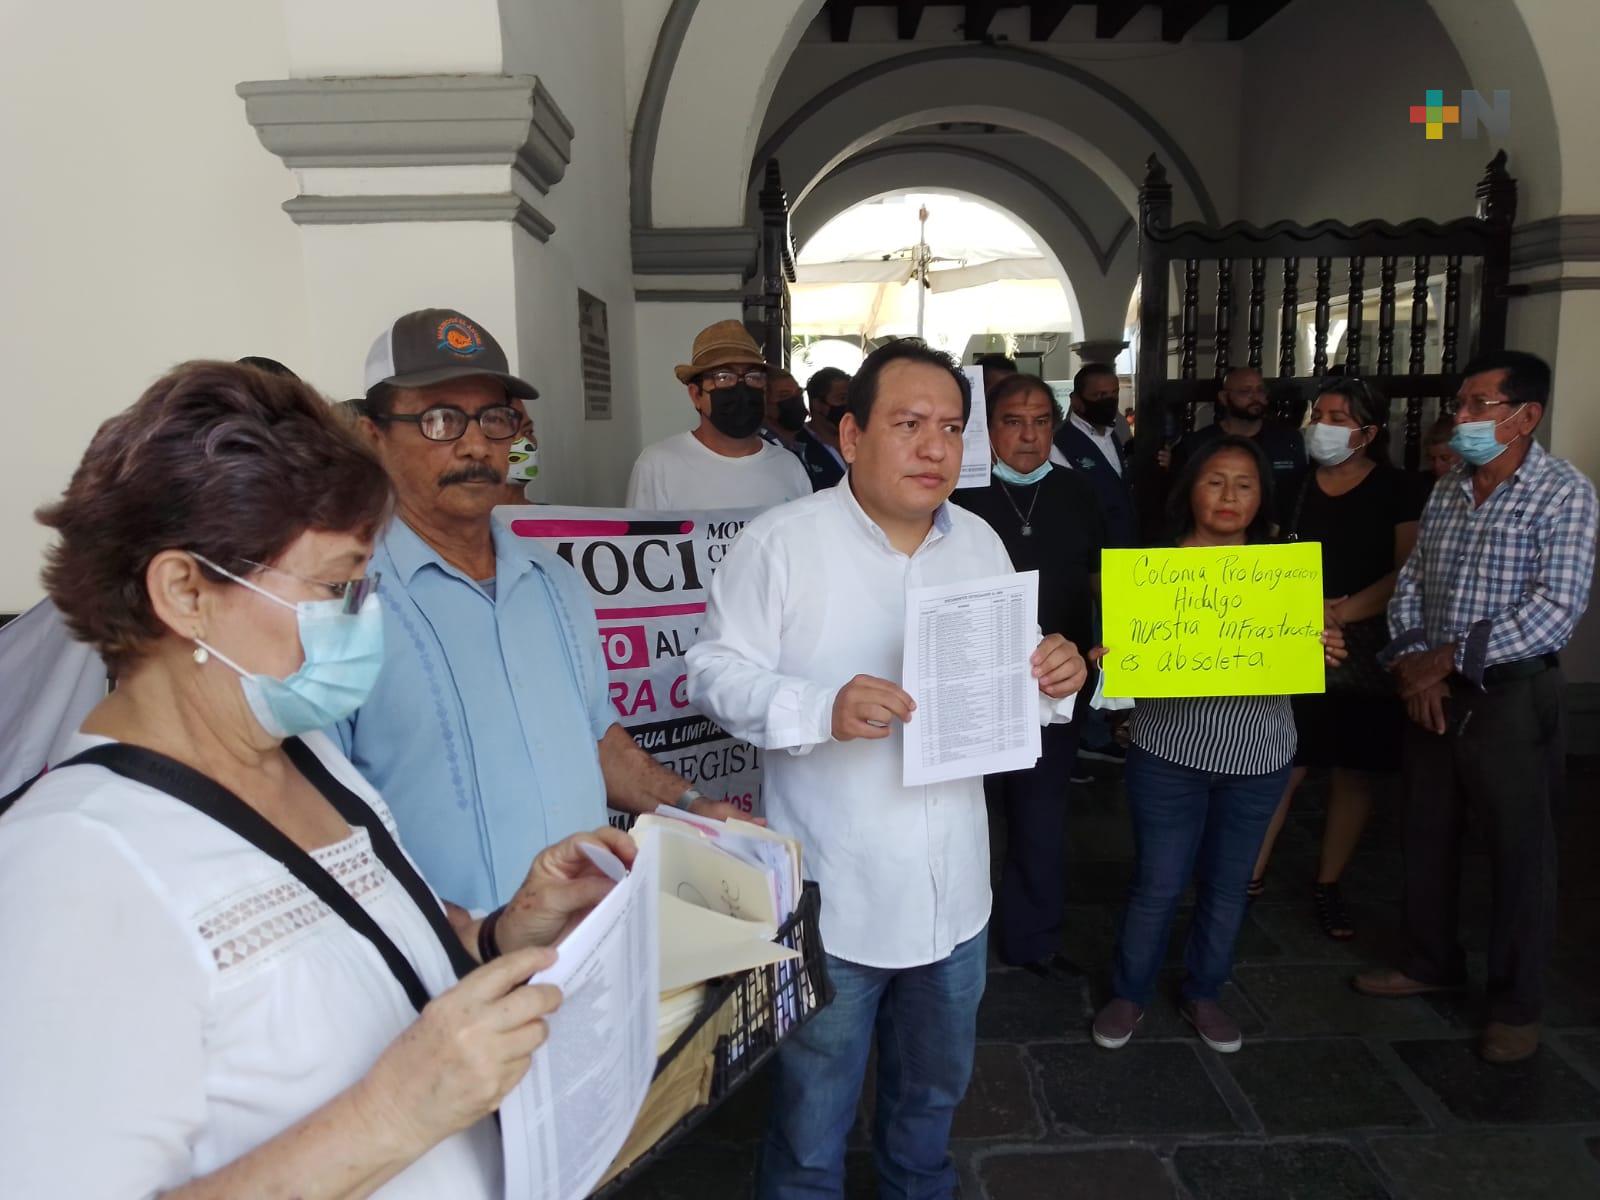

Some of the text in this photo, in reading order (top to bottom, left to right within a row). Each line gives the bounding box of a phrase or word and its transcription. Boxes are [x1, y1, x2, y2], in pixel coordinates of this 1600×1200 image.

[1133, 554, 1207, 587] Colonia
[1174, 584, 1242, 618] Hidalgo
[1120, 654, 1139, 672] es
[662, 741, 760, 785] EGIST
